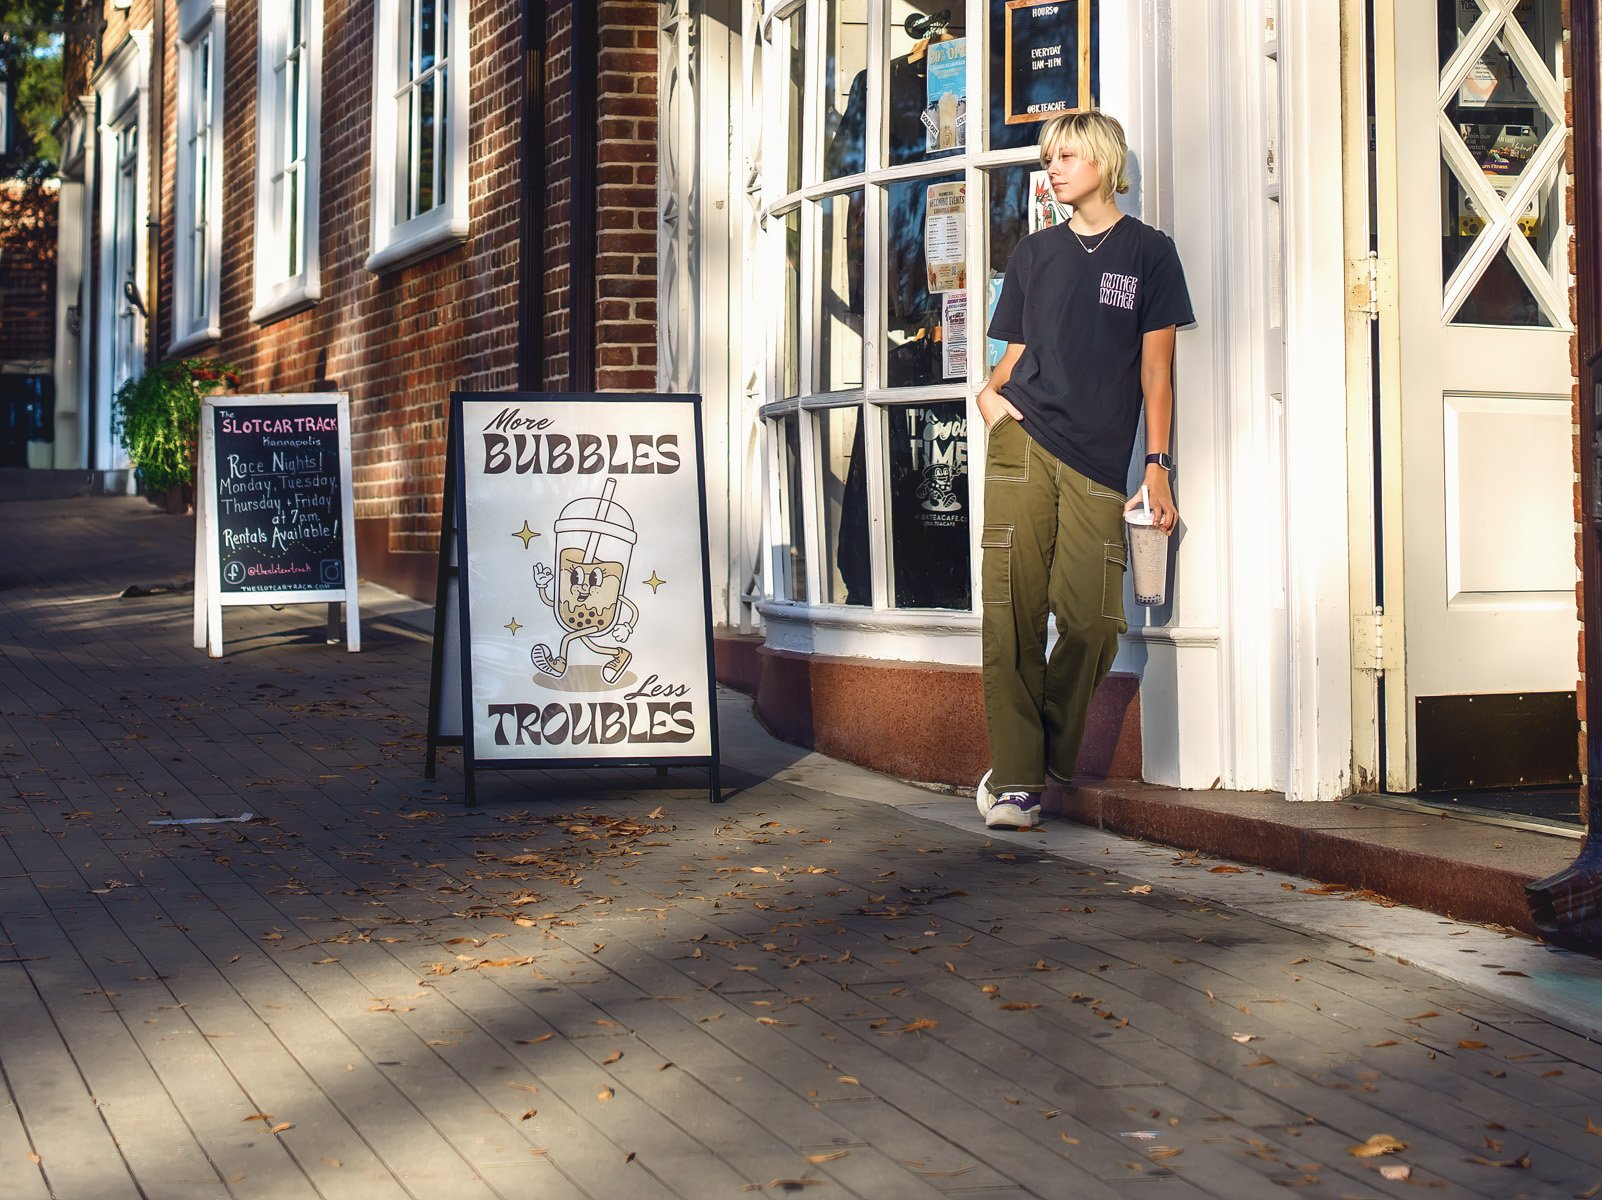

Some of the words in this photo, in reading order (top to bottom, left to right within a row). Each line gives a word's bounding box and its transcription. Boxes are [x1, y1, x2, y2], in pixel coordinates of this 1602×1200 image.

[1032, 8, 1054, 18] HOURS
[1031, 44, 1062, 58] EVERYDAY
[922, 113, 932, 127] SOLD
[949, 195, 965, 206] EVENTS
[1100, 272, 1138, 294] MOTHER
[1099, 287, 1135, 310] MOTHER
[219, 410, 234, 418] The
[483, 407, 555, 432] More
[262, 435, 321, 448] Kannapolis
[227, 453, 264, 478] Race
[272, 451, 323, 475] Nights!
[482, 433, 681, 475] BUBBLES
[219, 477, 277, 498] Monday,
[220, 494, 281, 515] Thursday
[295, 493, 332, 513] Friday
[271, 510, 286, 524] at
[222, 527, 268, 550] Rentals
[271, 519, 339, 552] Available!
[624, 674, 692, 701] Less
[488, 702, 695, 746] TROUBLES
